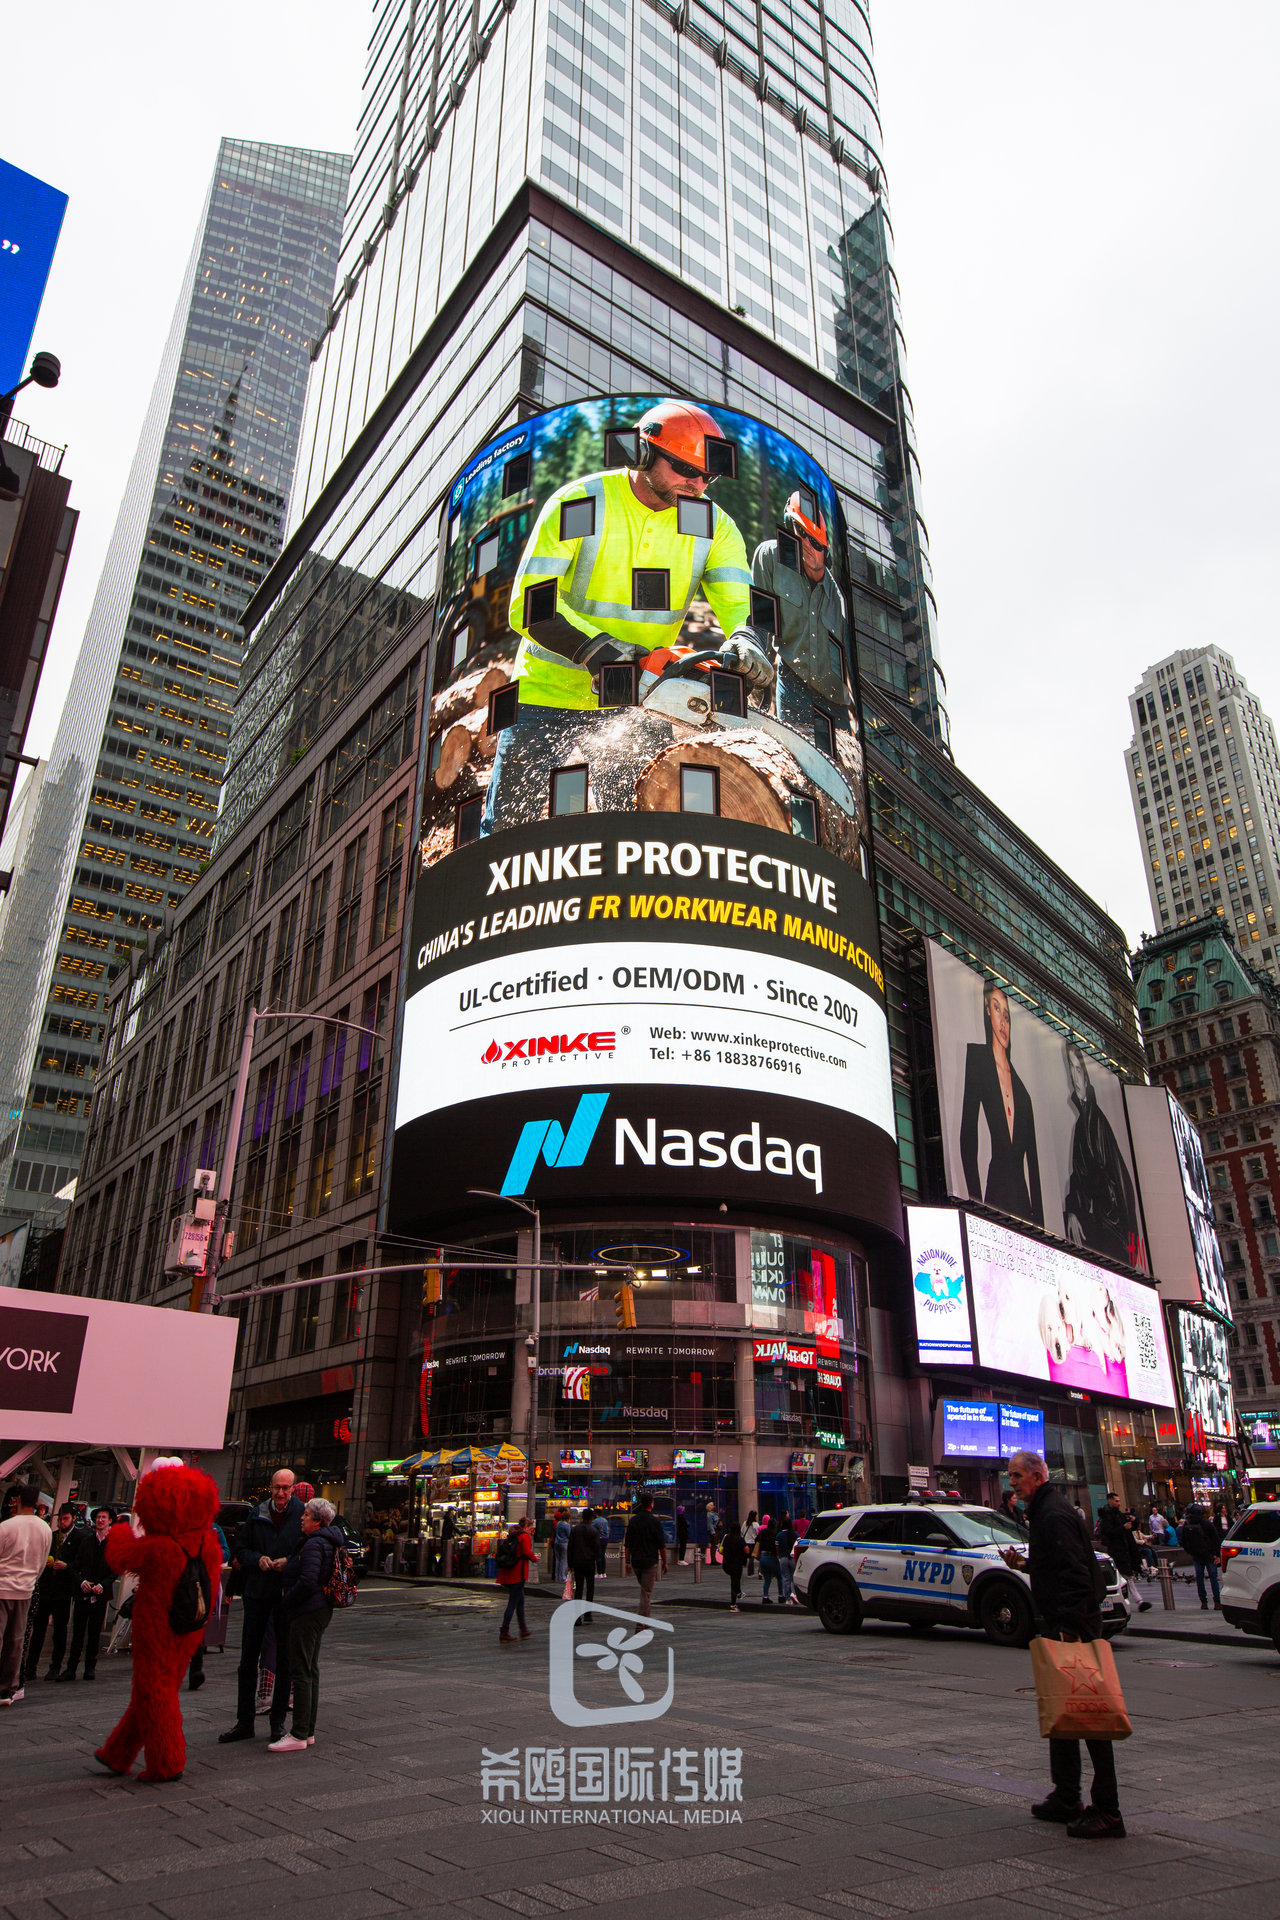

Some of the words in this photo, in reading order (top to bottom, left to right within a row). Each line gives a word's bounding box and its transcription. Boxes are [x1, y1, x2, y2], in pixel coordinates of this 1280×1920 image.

[464, 454, 493, 485] Leading
[493, 434, 526, 459] factory
[486, 842, 602, 896] XINKE
[617, 841, 838, 914] PROTECTIVE
[417, 920, 474, 971] CHINA'S
[478, 897, 582, 940] LEADING
[588, 895, 621, 920] FR
[629, 894, 777, 933] WORKWEAR
[459, 967, 588, 1012] UL-Certified
[612, 966, 745, 995] OEM/ODM
[766, 978, 819, 1012] Since
[823, 994, 859, 1028] 2007
[502, 1031, 617, 1062] XINKE
[649, 1026, 686, 1040] Web:
[690, 1029, 848, 1070] www.xinkeprotective.com
[501, 1051, 615, 1070] PROTECTIVE
[649, 1047, 675, 1060] Tel:
[681, 1049, 711, 1062] +86
[716, 1050, 802, 1076] 18838766916
[615, 1118, 824, 1195] Nasdaq
[916, 1248, 958, 1269] NATIONWIDE
[922, 1299, 957, 1315] PUPPIES
[578, 1345, 611, 1355] Nasdaq
[626, 1346, 664, 1355] REWRITE
[668, 1347, 716, 1356] TOMORROW
[622, 1405, 669, 1421] Nasdaq
[946, 1404, 960, 1413] The
[960, 1405, 979, 1414] future
[979, 1406, 987, 1414] of
[946, 1414, 967, 1422] spend
[967, 1413, 973, 1421] is
[973, 1413, 979, 1421] in
[979, 1414, 995, 1422] flow.
[902, 1559, 956, 1585] NYPD
